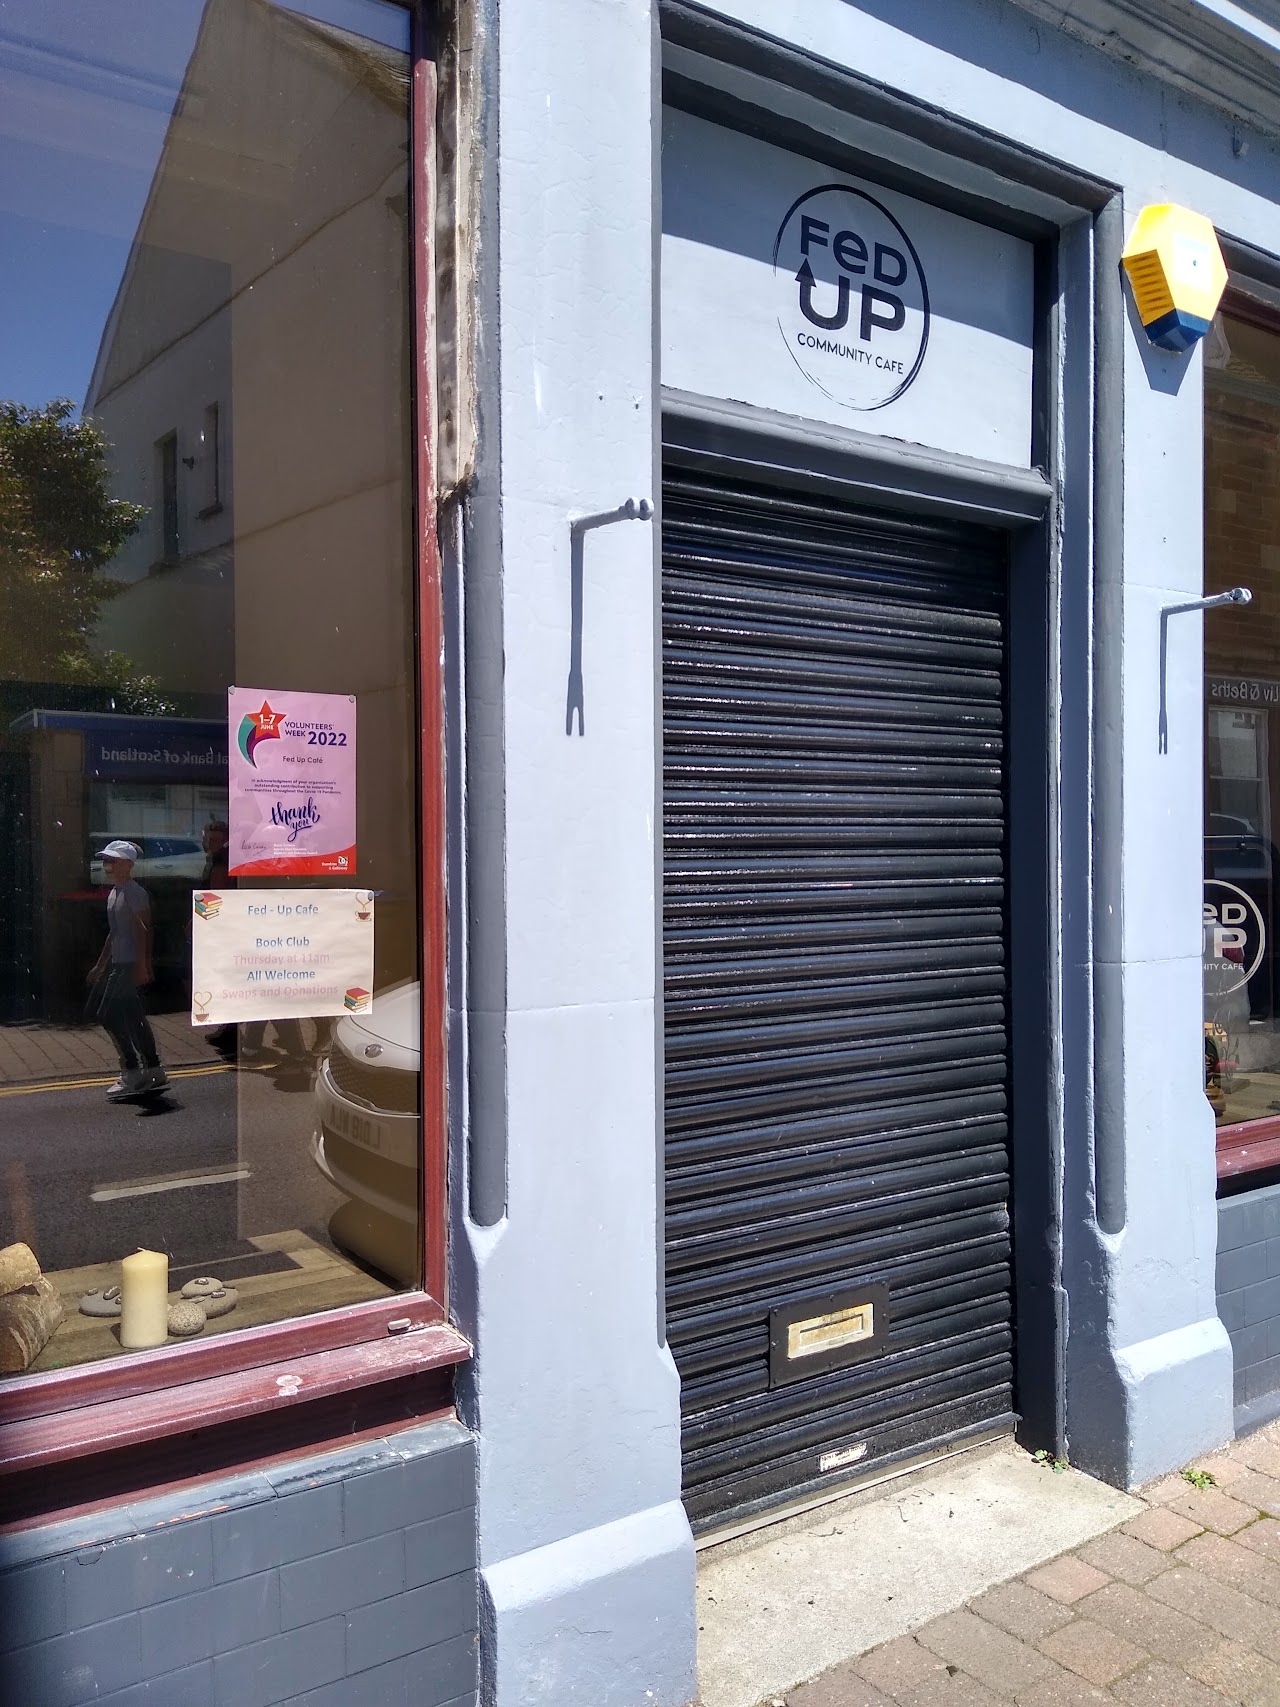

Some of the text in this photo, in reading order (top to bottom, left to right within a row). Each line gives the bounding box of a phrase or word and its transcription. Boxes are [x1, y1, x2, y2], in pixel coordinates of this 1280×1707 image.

[796, 259, 906, 342] UP
[797, 332, 904, 375] COMMUNITY CAFE
[307, 731, 347, 746] 2022
[297, 756, 306, 764] Up
[269, 796, 320, 825] thank
[287, 818, 312, 842] you
[248, 905, 267, 915] Fed
[277, 905, 293, 917] Up
[295, 904, 319, 915] Cafe
[1202, 903, 1248, 925] eD
[256, 936, 310, 948] Book Club
[233, 953, 330, 966] Thursday at 11am
[246, 969, 316, 981] All Welcome
[222, 984, 338, 1000] Swaps and Donations
